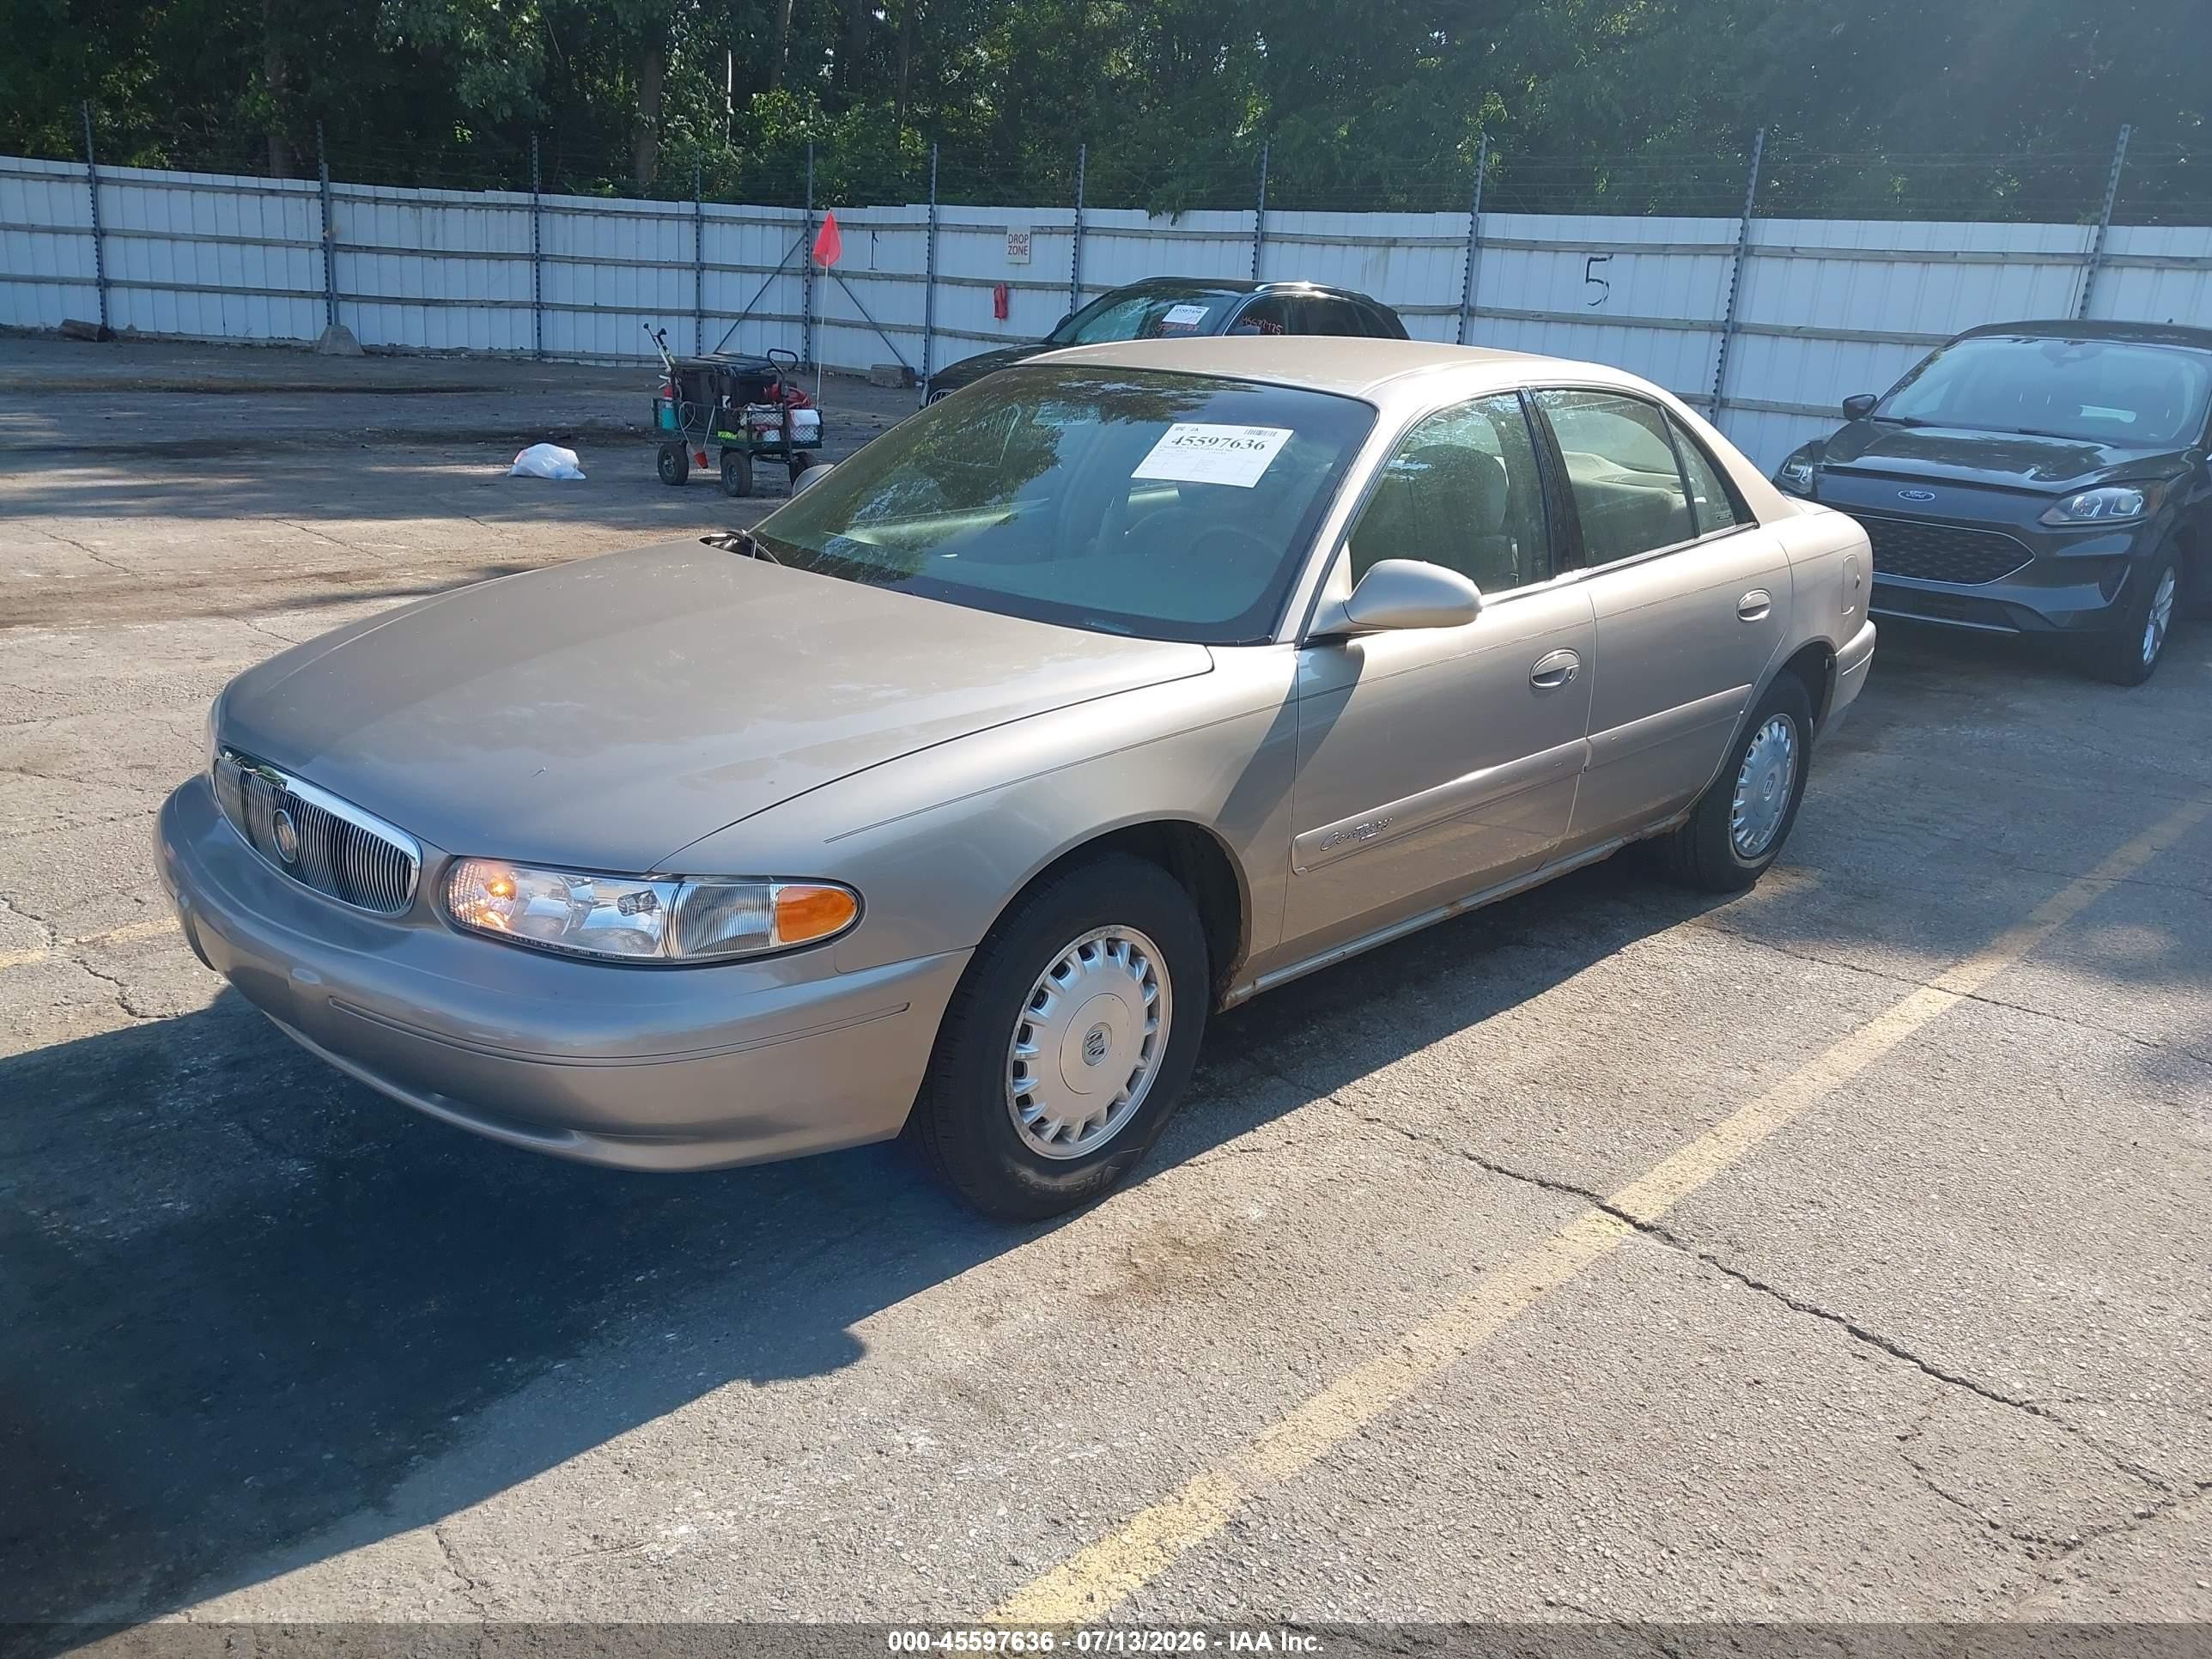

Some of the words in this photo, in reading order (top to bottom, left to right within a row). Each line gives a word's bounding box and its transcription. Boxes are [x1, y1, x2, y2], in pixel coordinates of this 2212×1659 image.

[1007, 234, 1030, 245] DROP
[1007, 245, 1029, 256] ZONE
[1585, 252, 1614, 307] 5
[1171, 434, 1269, 451] 45597636
